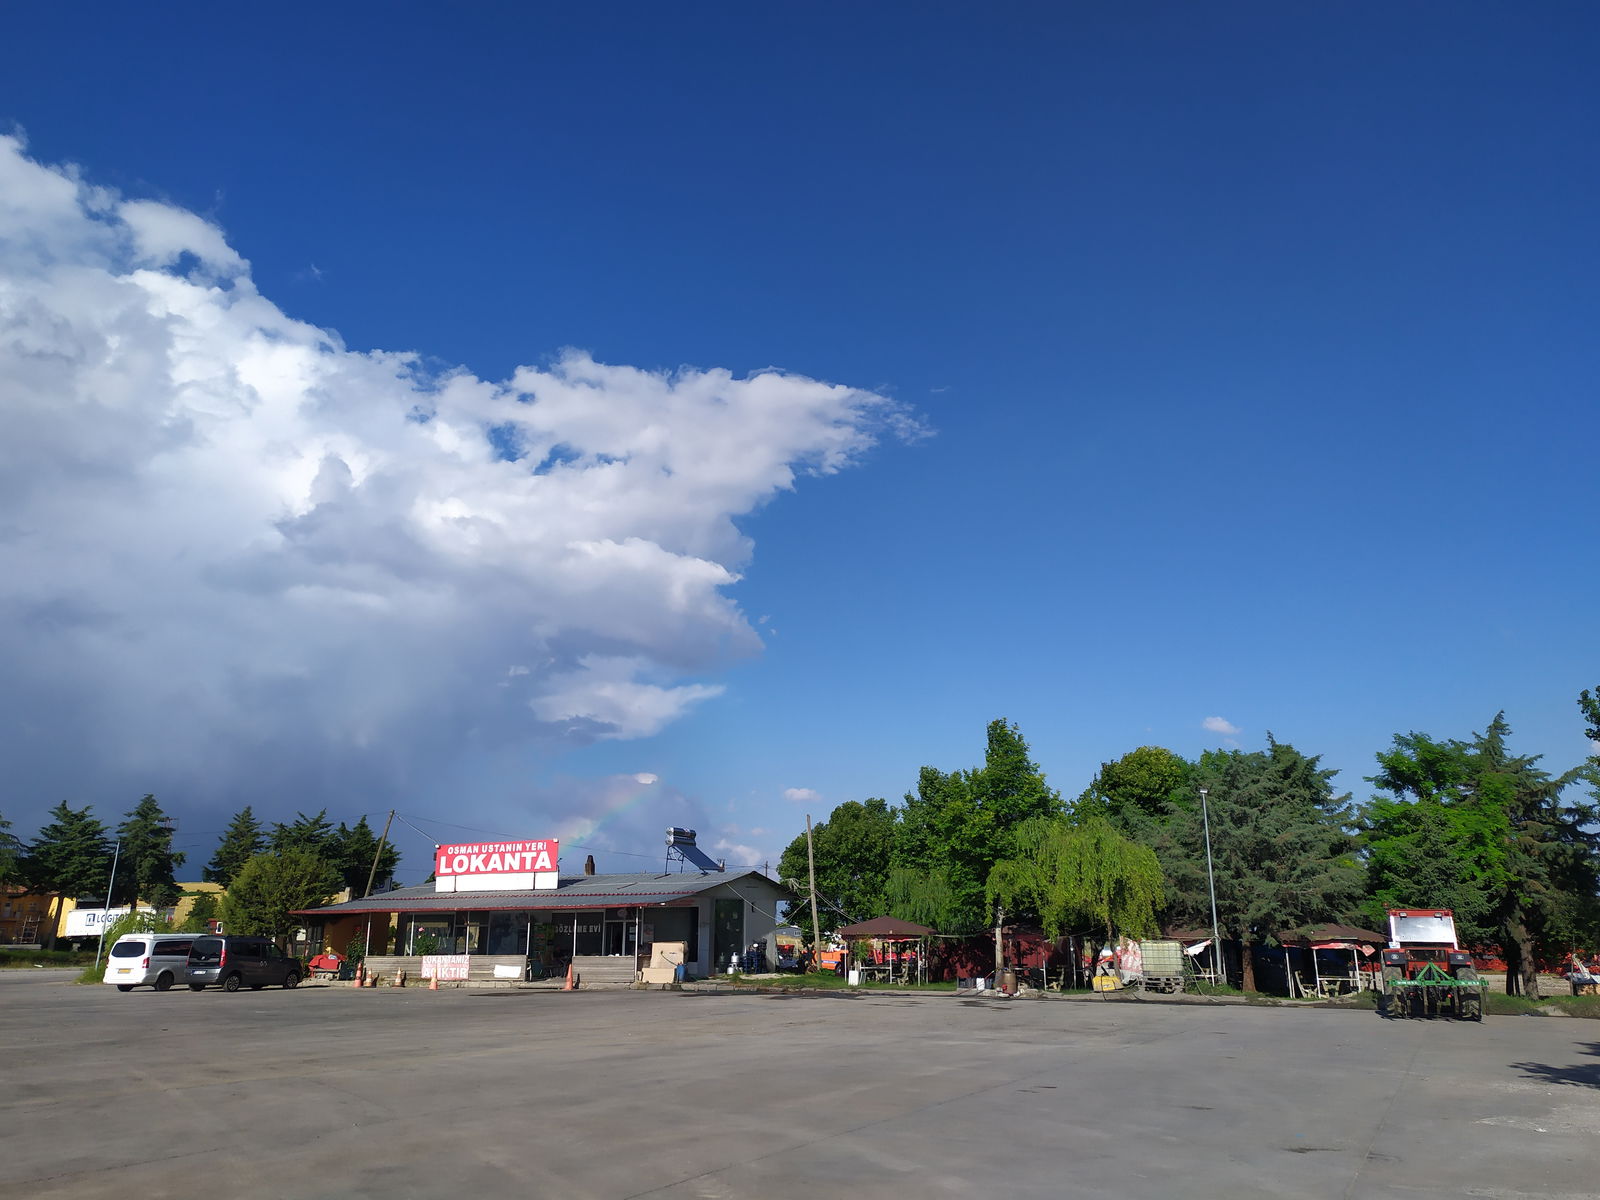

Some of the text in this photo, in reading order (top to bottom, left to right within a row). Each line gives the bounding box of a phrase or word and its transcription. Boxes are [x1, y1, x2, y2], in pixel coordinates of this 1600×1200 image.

[448, 845, 479, 854] OSMAN
[481, 843, 522, 853] USTANIN
[439, 851, 552, 874] LOKANTA
[554, 923, 587, 933] ÖZLME
